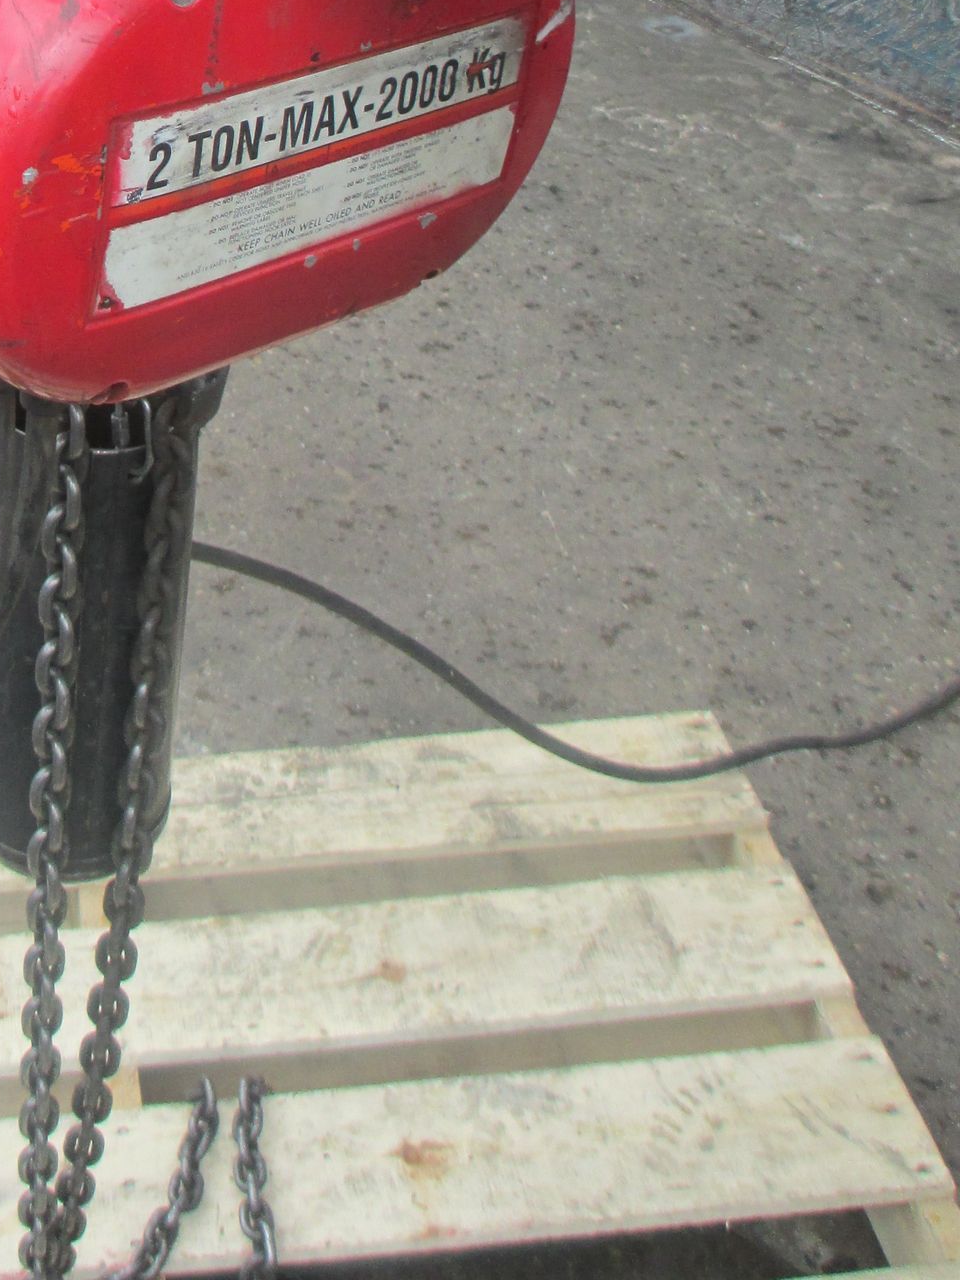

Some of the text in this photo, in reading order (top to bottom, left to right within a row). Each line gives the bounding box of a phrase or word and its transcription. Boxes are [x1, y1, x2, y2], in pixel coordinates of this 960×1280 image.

[146, 142, 172, 191] 2
[188, 58, 459, 178] TON-MAX-2000
[465, 46, 507, 94] Kg
[237, 237, 261, 252] KEEP
[264, 227, 296, 244] CHAIN
[298, 217, 323, 232] WELL
[325, 207, 352, 224] OILED
[355, 199, 376, 213] AND
[378, 190, 402, 205] READ
